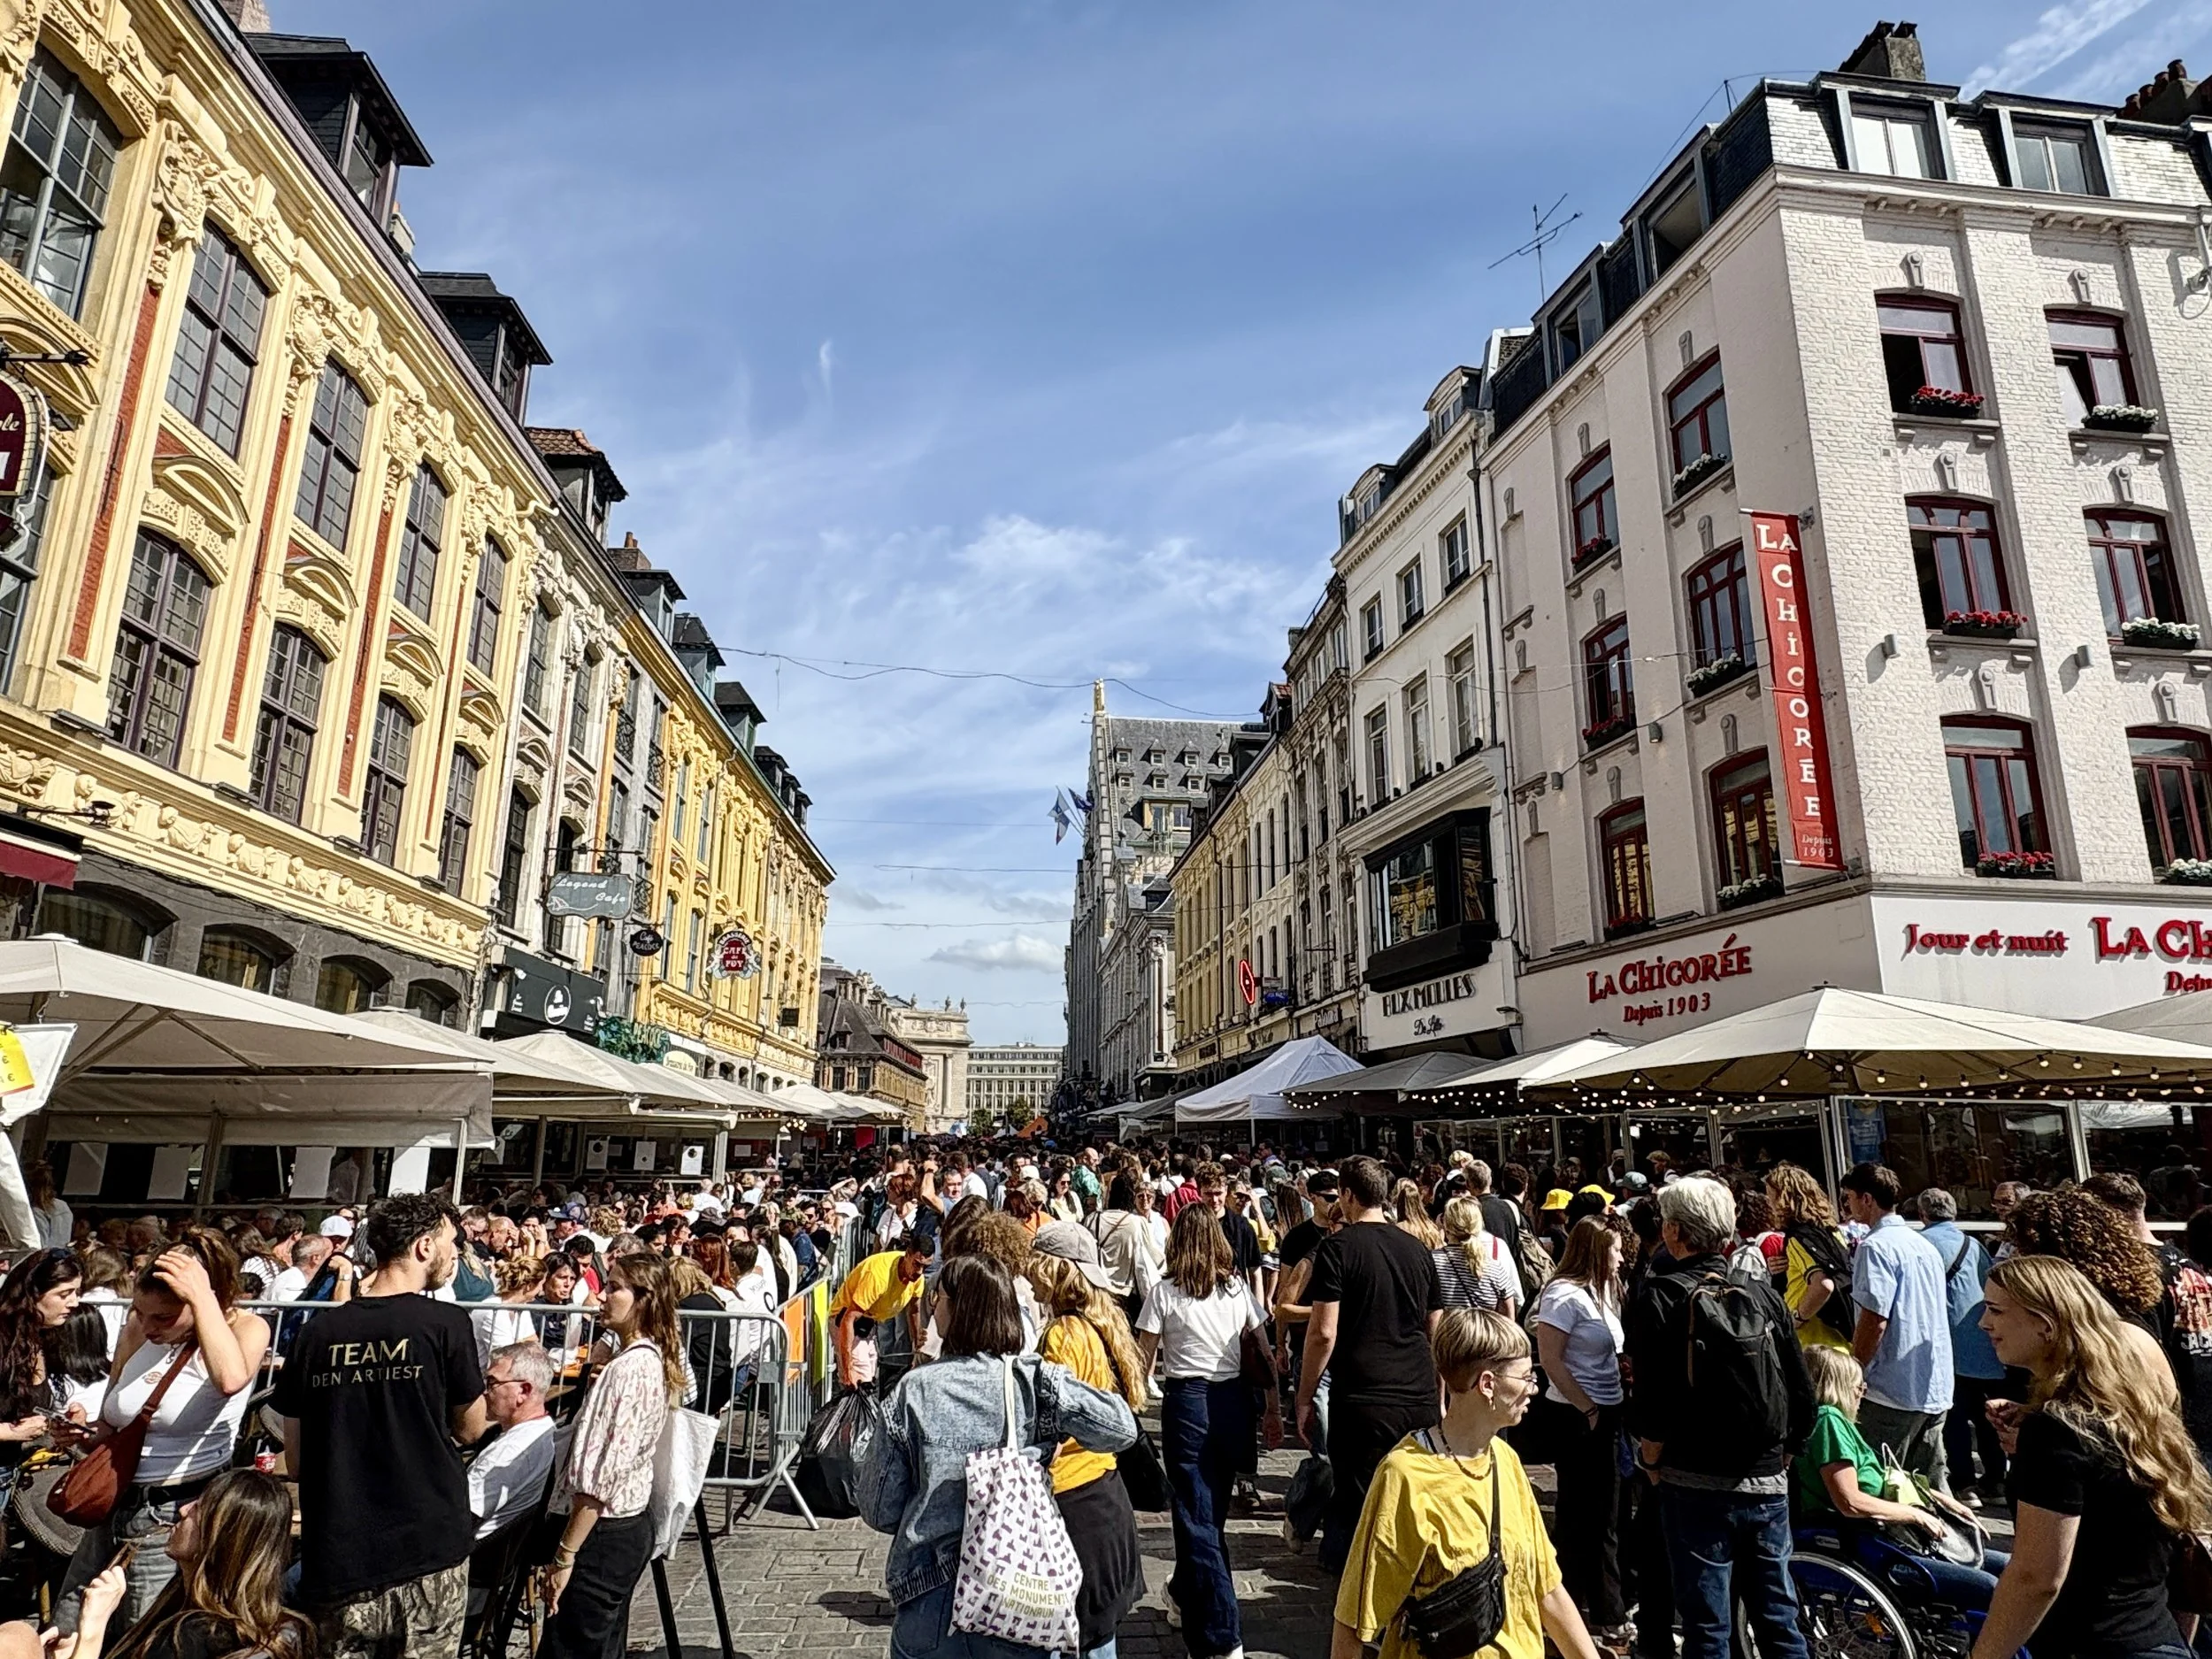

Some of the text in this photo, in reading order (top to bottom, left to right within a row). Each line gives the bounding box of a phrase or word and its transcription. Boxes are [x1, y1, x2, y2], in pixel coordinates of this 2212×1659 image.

[1756, 524, 1798, 551] LA
[1801, 834, 1832, 846] Depuis
[1803, 847, 1833, 857] 1903
[556, 877, 608, 890] Legend
[1906, 924, 1970, 954] Jour
[1974, 929, 2004, 950] et
[2008, 930, 2070, 952] nuit
[2092, 917, 2152, 957] LA
[1382, 973, 1476, 1017] AUX MOULES
[1586, 971, 1619, 1003] LA
[1623, 992, 1711, 1026] Depuis 1903
[328, 1338, 410, 1367] TEAM
[312, 1365, 424, 1388] DEN ARTIEST
[987, 1575, 1007, 1592] DES
[1014, 1572, 1048, 1591] CENTRE
[1003, 1596, 1056, 1618] NATIONAUX
